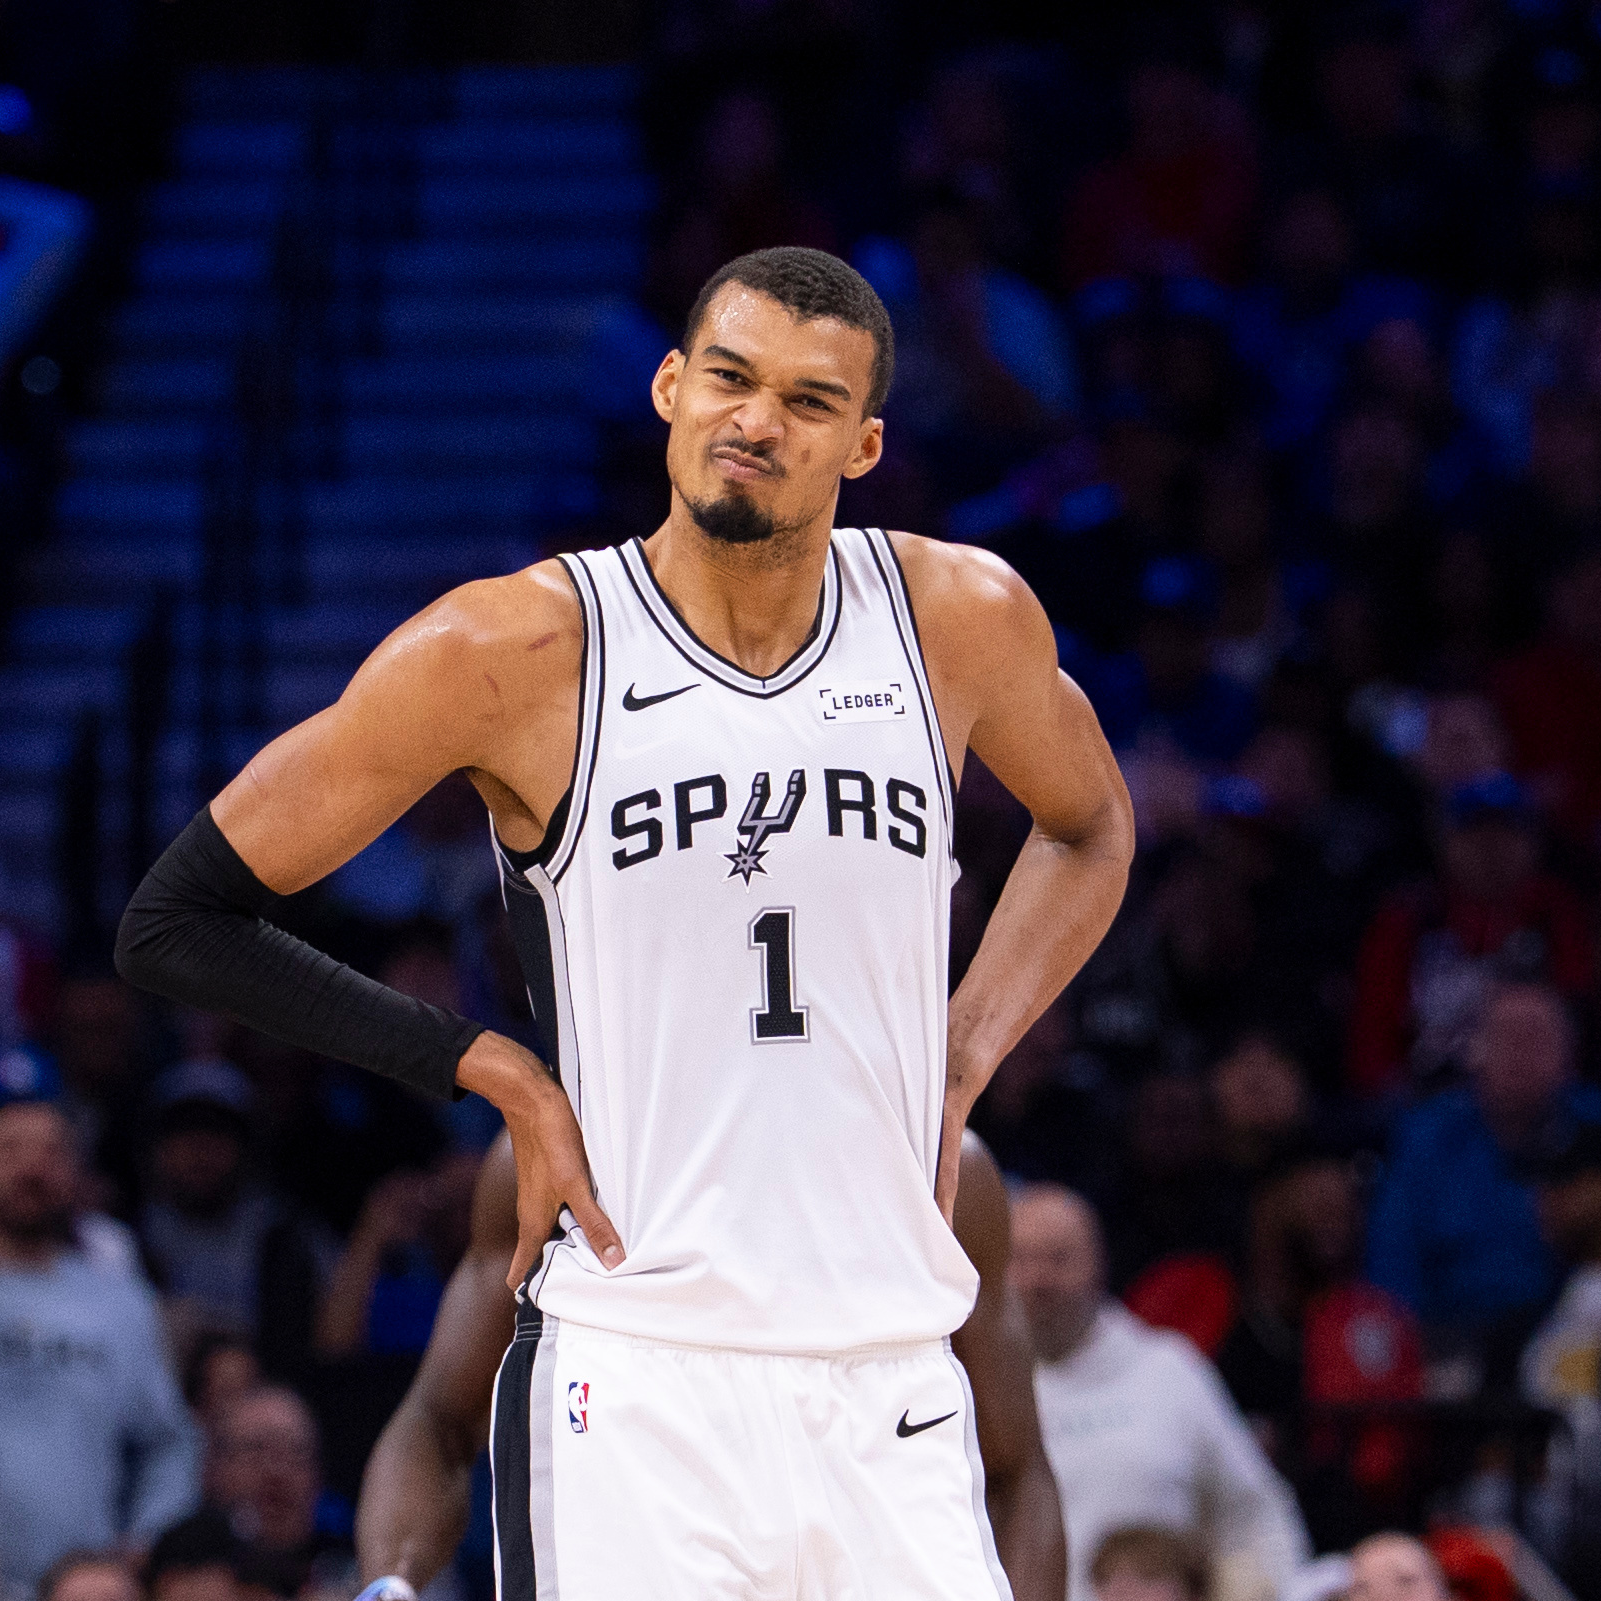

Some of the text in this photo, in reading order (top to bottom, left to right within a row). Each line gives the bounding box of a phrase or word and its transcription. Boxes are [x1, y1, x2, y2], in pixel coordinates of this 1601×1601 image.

[832, 693, 893, 710] LEDGER
[610, 768, 927, 888] SPURS
[748, 905, 810, 1045] 1
